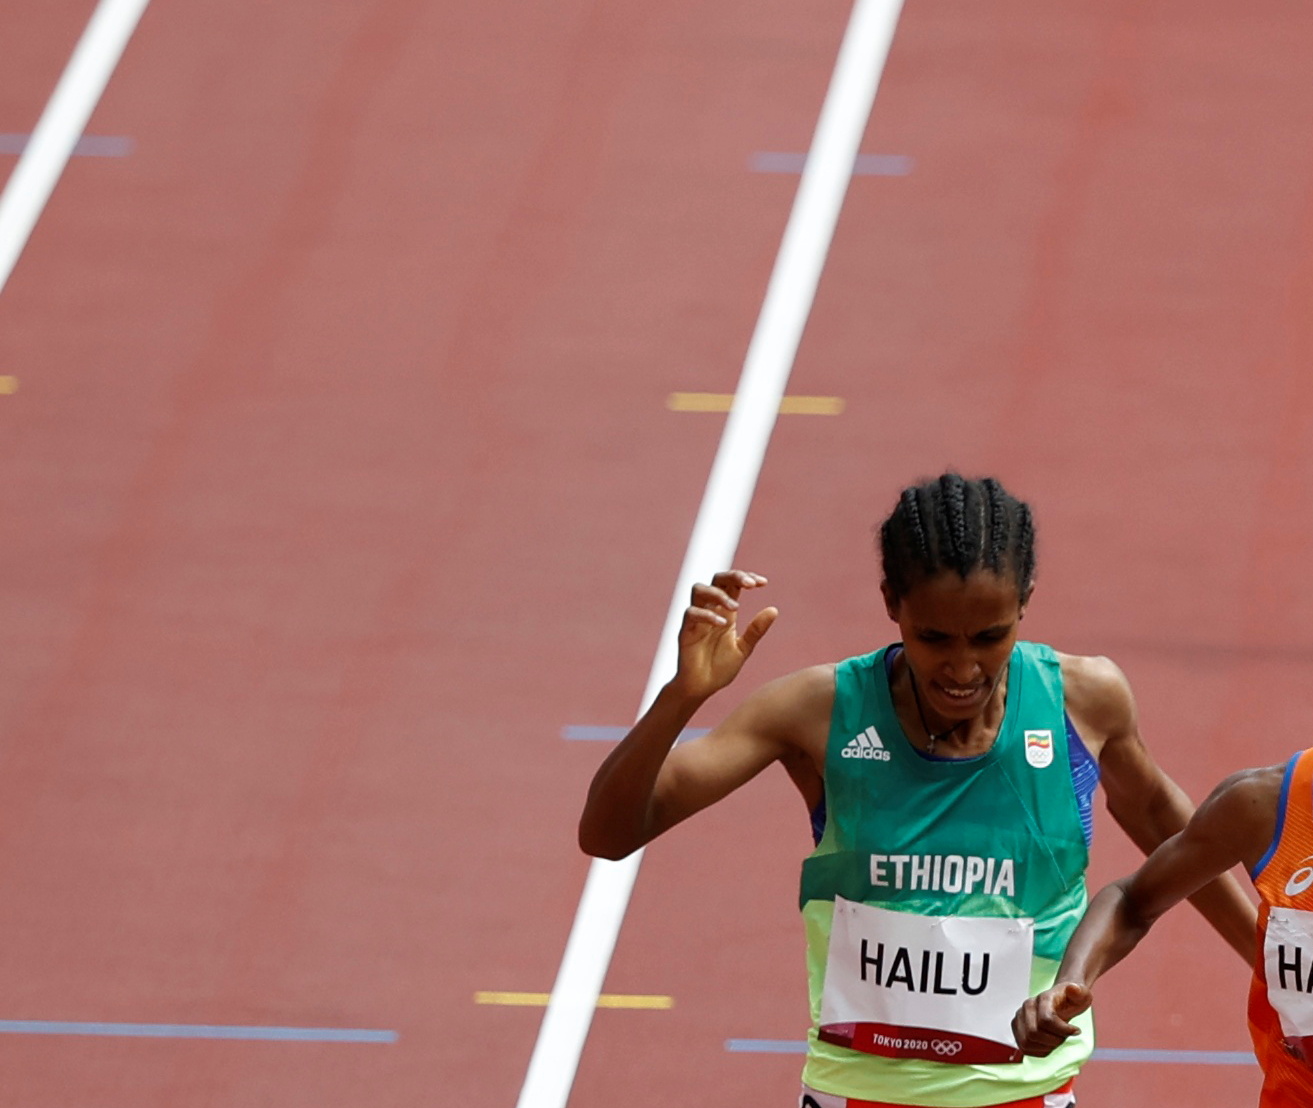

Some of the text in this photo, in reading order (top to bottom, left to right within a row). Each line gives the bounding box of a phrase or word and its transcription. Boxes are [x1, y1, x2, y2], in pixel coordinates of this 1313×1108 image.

[841, 747, 891, 762] adidas
[869, 853, 1015, 897] ETHIOPIA
[860, 938, 990, 996] HAILU
[872, 1033, 928, 1050] TOKYO 2020
